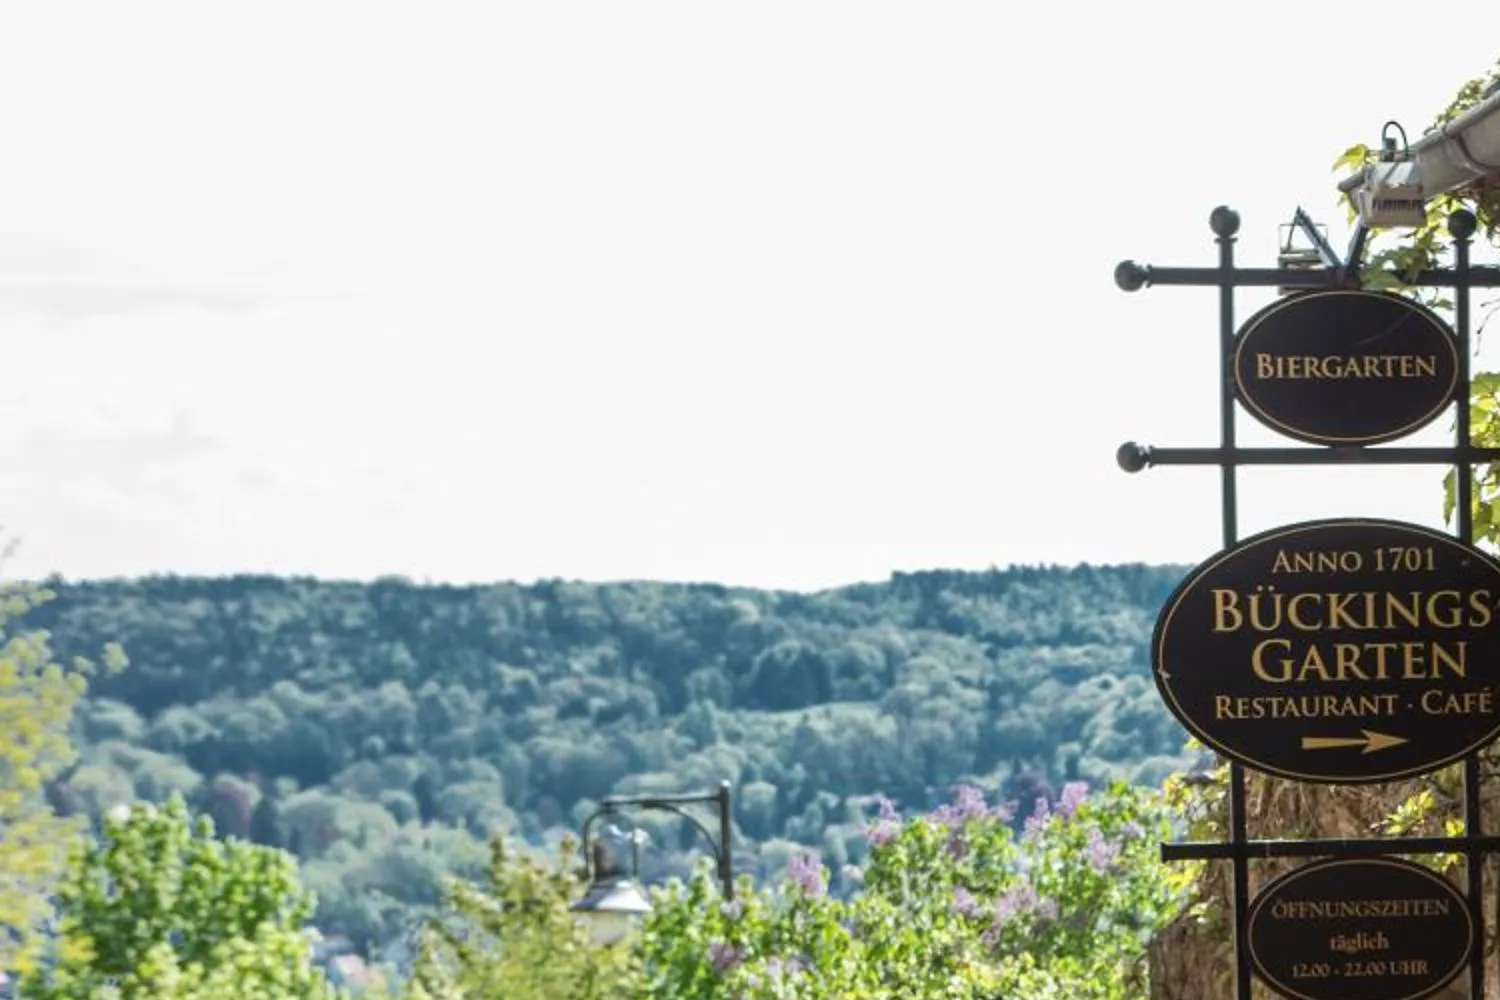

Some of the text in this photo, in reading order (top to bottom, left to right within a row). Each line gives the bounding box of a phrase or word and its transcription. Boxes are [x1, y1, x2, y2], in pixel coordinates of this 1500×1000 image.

[1255, 353, 1437, 379] BIERGARTEN
[1272, 547, 1436, 574] ANNO 1701
[1211, 585, 1494, 633] BÜCKINGS
[1251, 638, 1467, 683] GARTEN
[1215, 686, 1494, 719] RESTAURANT CAFÉ
[1330, 931, 1389, 953] täglich
[1390, 960, 1429, 975] UHR
